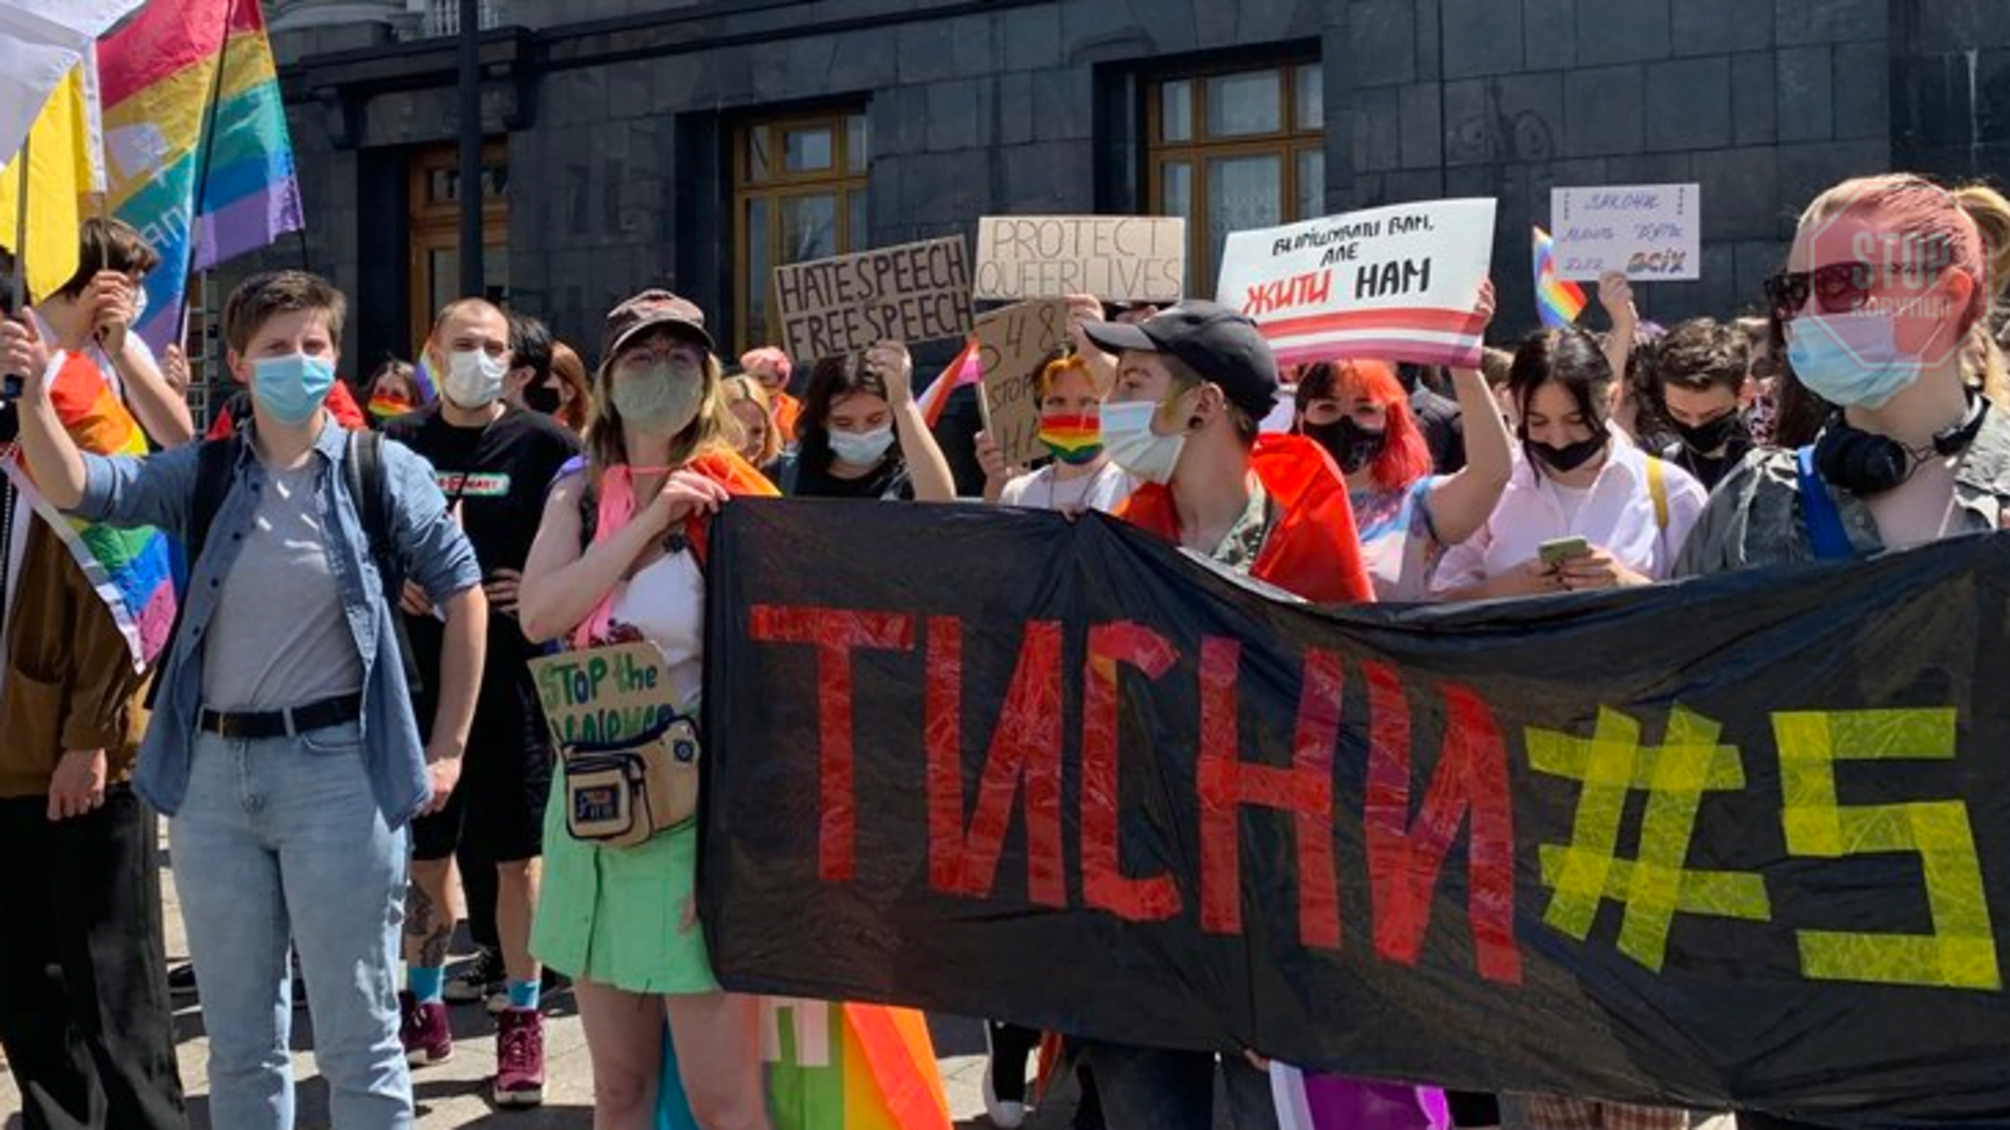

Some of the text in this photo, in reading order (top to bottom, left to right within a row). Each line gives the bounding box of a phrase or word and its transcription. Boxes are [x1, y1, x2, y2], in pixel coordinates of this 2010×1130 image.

[991, 219, 1168, 260] PROTECT
[1319, 241, 1360, 268] АЛЕ
[1241, 256, 1431, 315] ЖИТИ НАМ
[538, 652, 658, 709] STOP the
[749, 604, 2001, 990] ТИСНИ #5
